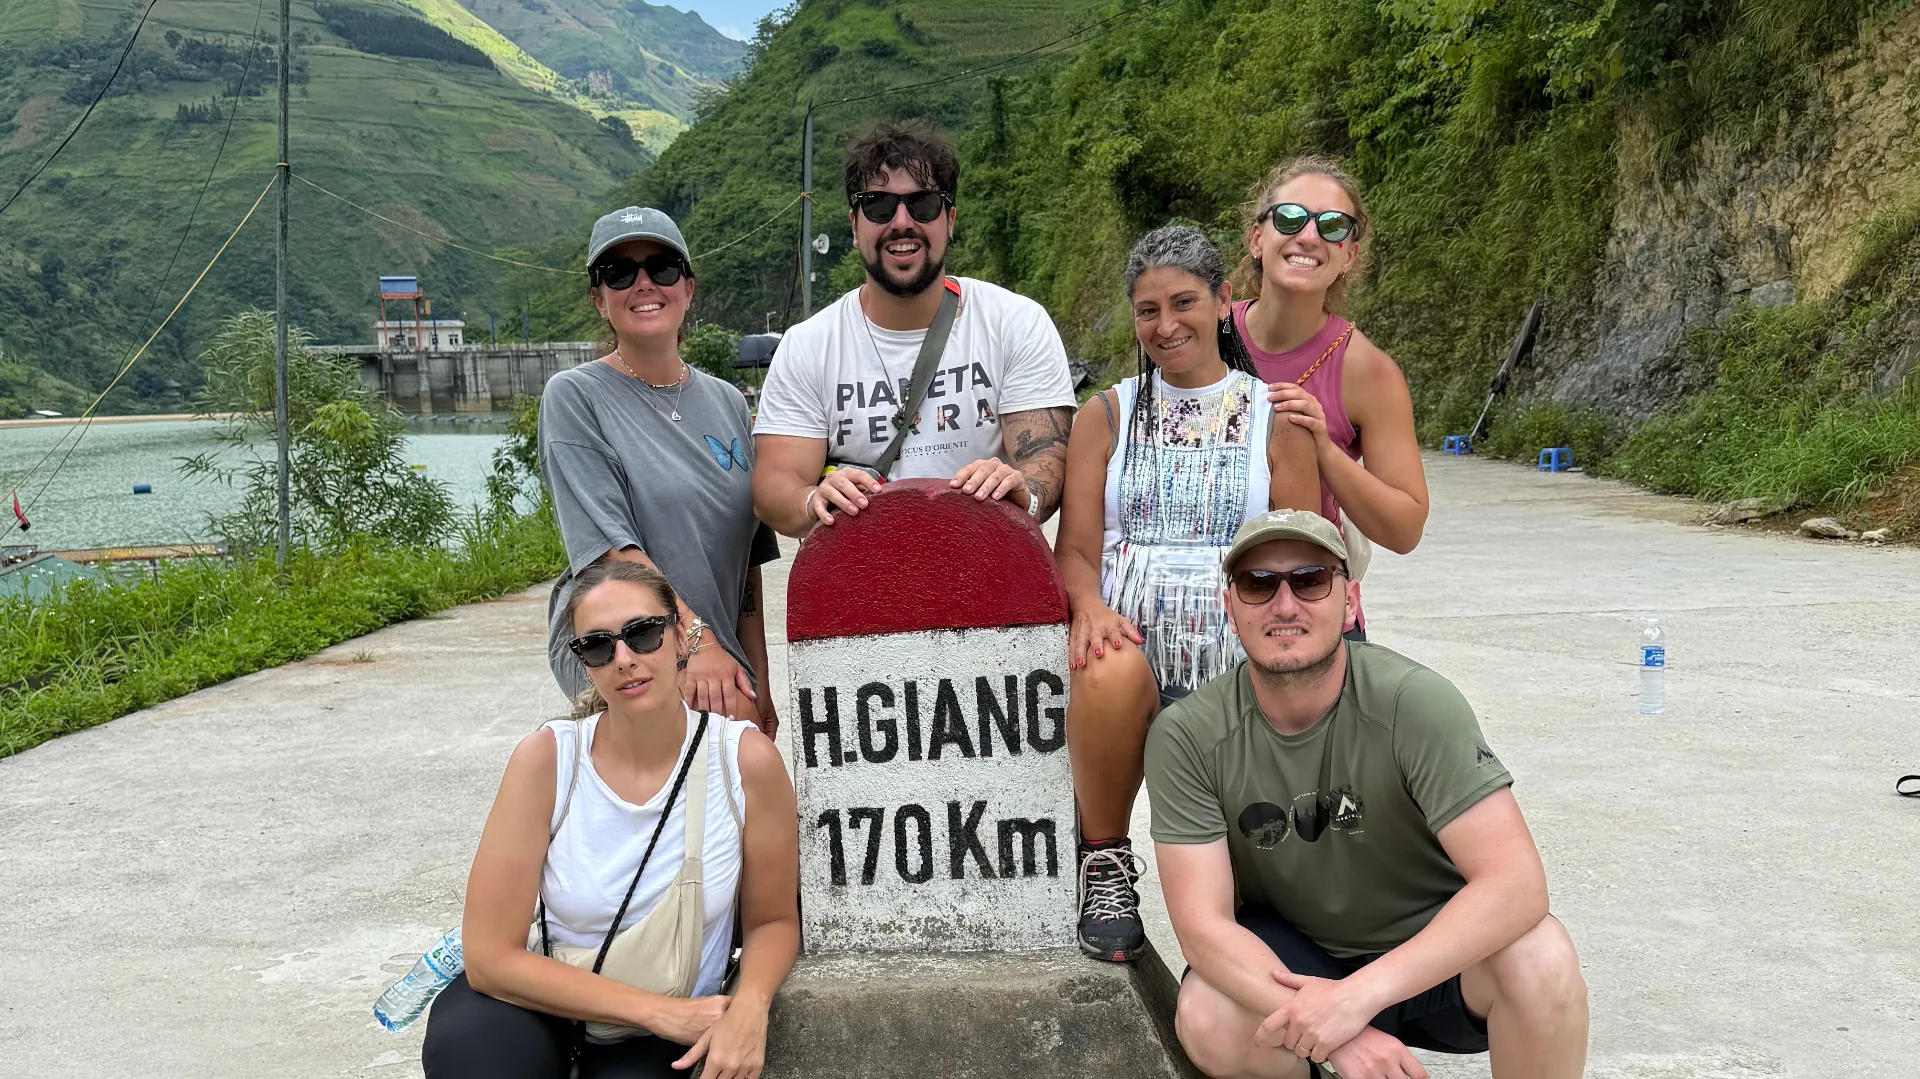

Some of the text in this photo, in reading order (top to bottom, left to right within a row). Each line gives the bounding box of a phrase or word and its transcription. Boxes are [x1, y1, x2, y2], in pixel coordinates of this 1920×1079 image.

[798, 669, 1066, 768] H.GIANG
[817, 800, 1058, 885] 170 Km
